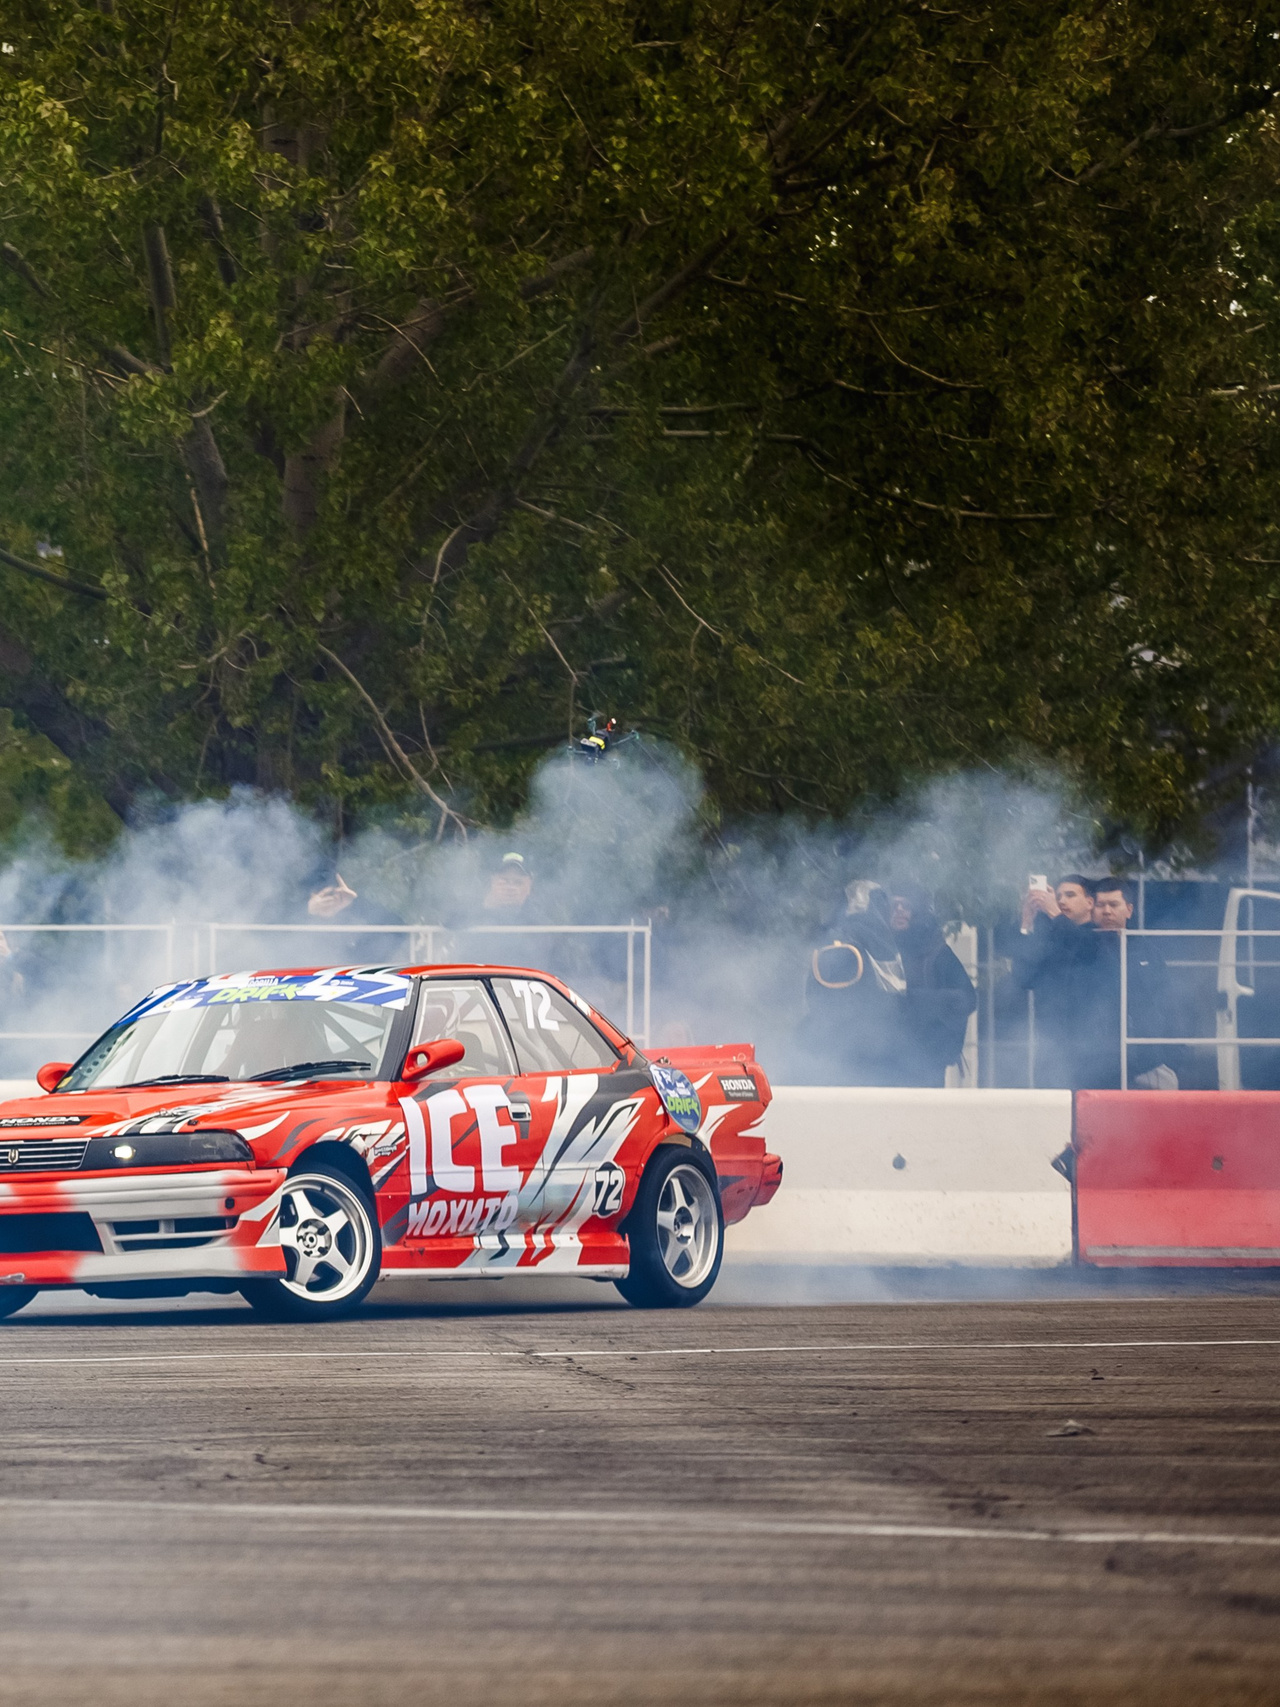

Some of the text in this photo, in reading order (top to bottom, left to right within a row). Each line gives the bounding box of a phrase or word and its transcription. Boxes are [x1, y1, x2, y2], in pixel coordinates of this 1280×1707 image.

[208, 984, 304, 1003] DRIFT
[510, 980, 560, 1031] 72
[720, 1079, 756, 1091] HONDA
[399, 1085, 524, 1196] ICE
[594, 1170, 623, 1211] 72
